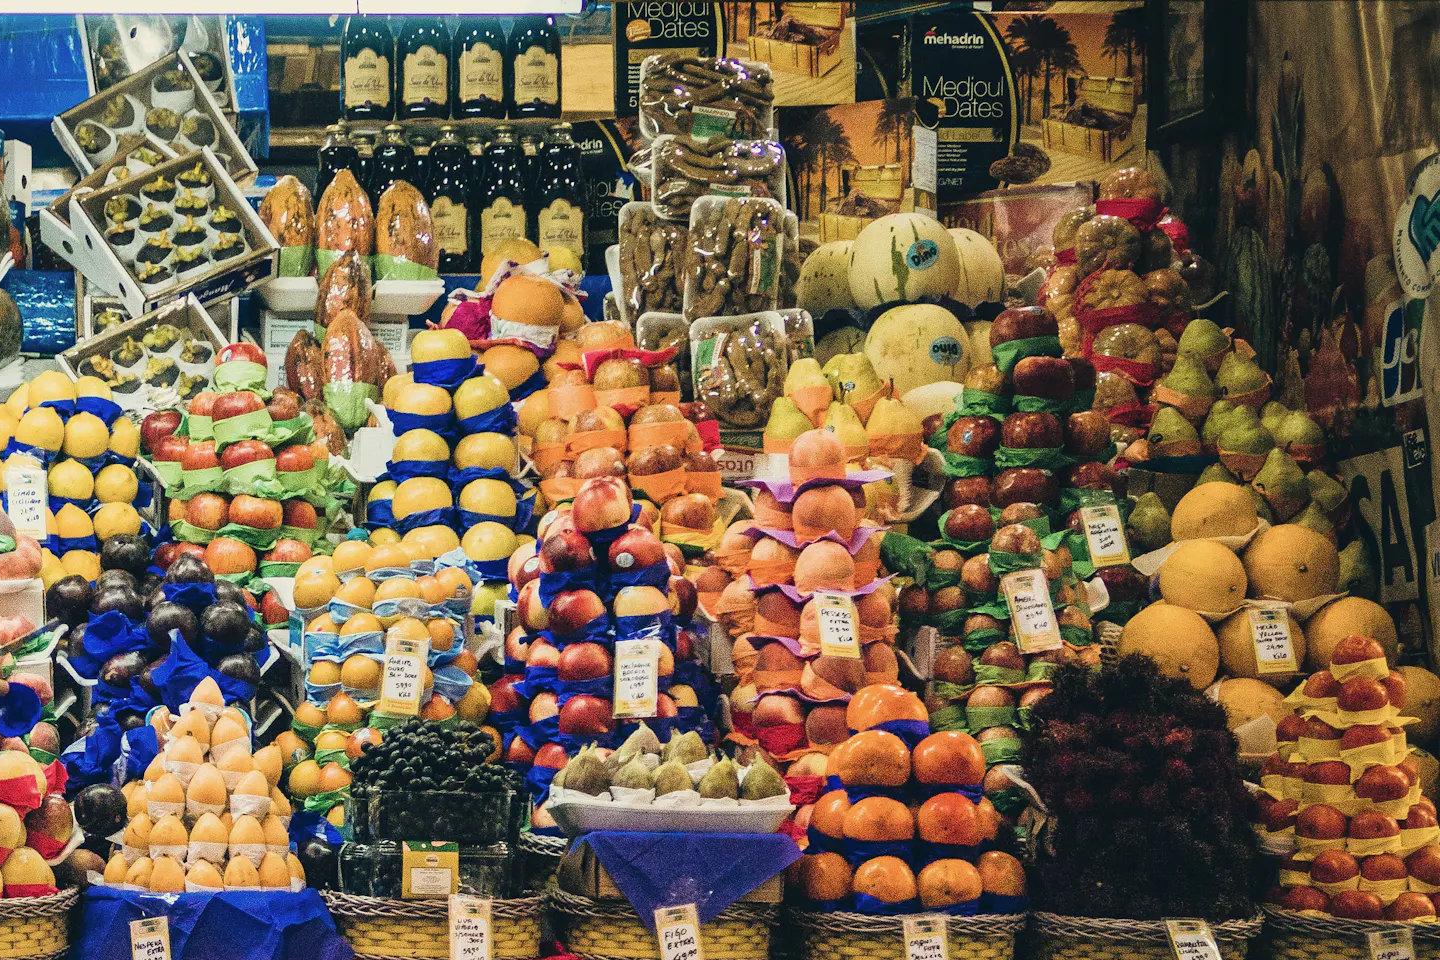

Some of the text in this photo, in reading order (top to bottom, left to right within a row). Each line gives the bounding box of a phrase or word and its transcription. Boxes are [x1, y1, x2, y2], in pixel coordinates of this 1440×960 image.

[647, 18, 711, 40] Dates
[924, 32, 985, 44] mehadrin
[922, 74, 1004, 101] Medjoul
[943, 96, 1004, 118] Dates
[910, 245, 937, 267] Dino
[932, 343, 958, 356] Dino
[716, 459, 754, 474] utas
[664, 928, 687, 941] FIGO
[667, 937, 695, 950] EXTRA
